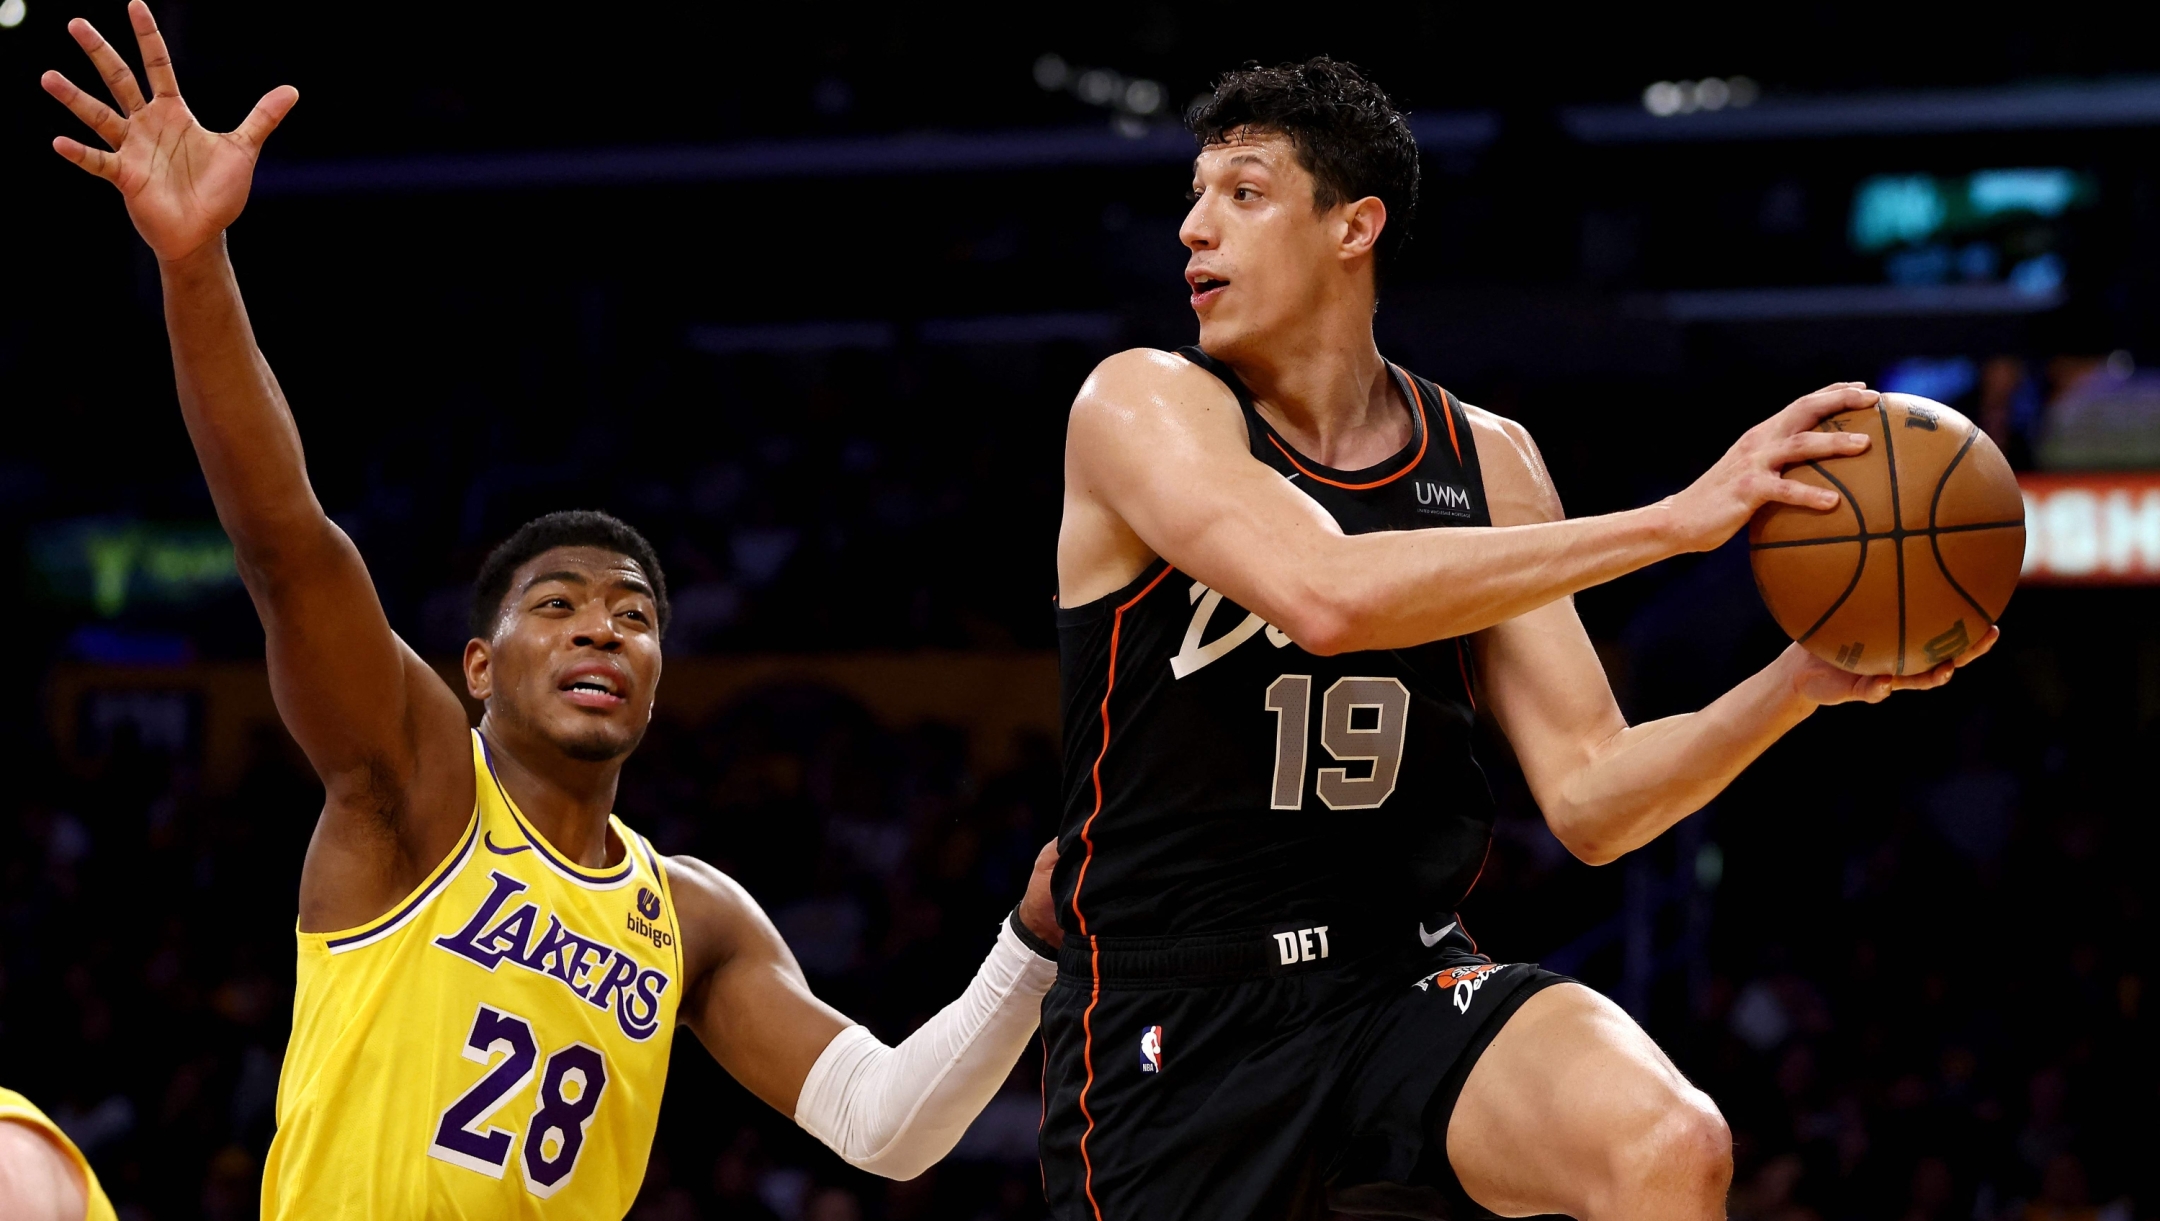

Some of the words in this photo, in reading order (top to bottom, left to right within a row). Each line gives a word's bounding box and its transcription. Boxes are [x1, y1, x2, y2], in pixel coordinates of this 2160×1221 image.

[1415, 481, 1471, 510] UWM
[1265, 674, 1411, 811] 19
[626, 911, 672, 949] bibigo
[1273, 925, 1329, 966] DET
[431, 868, 671, 1043] LAKERS
[1142, 1063, 1155, 1072] NBA
[427, 1001, 610, 1200] 28
